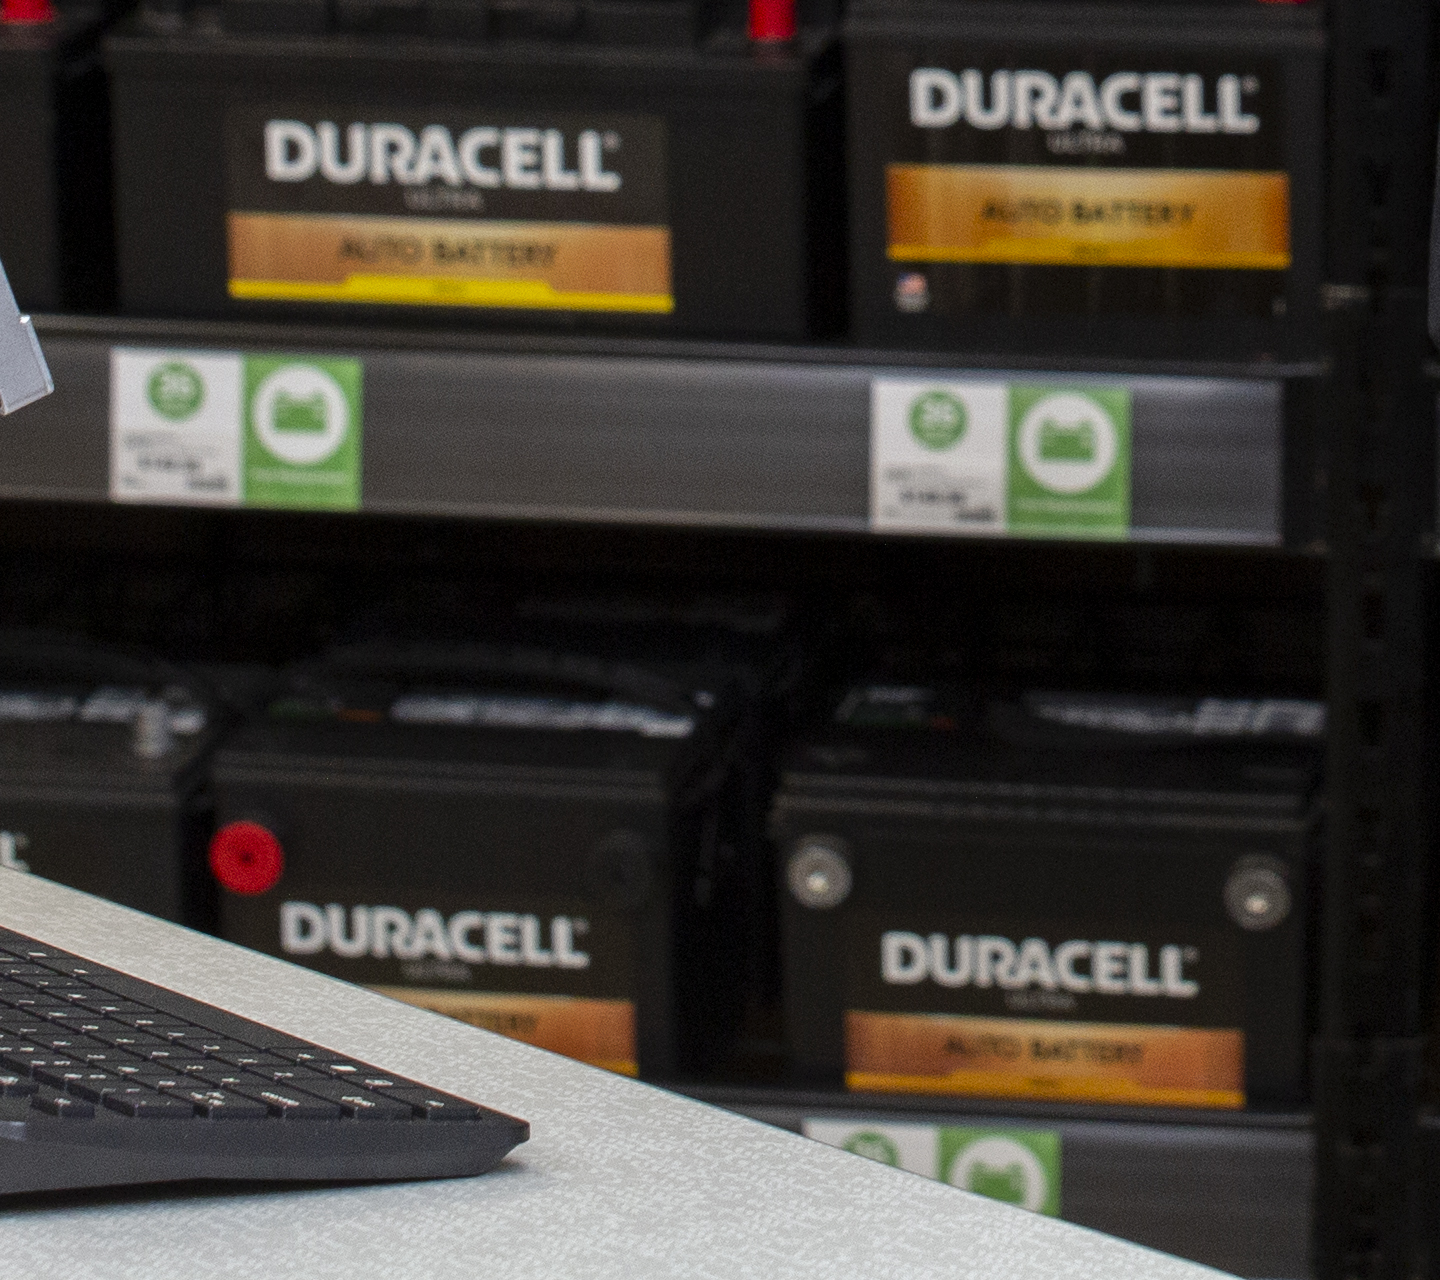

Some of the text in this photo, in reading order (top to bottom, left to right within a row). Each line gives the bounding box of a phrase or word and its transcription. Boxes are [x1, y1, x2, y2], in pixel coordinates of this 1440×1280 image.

[908, 67, 1259, 134] DURACELL
[264, 119, 622, 193] DURACELL
[278, 900, 591, 970] DURACELL
[880, 930, 1199, 998] DURACELL
